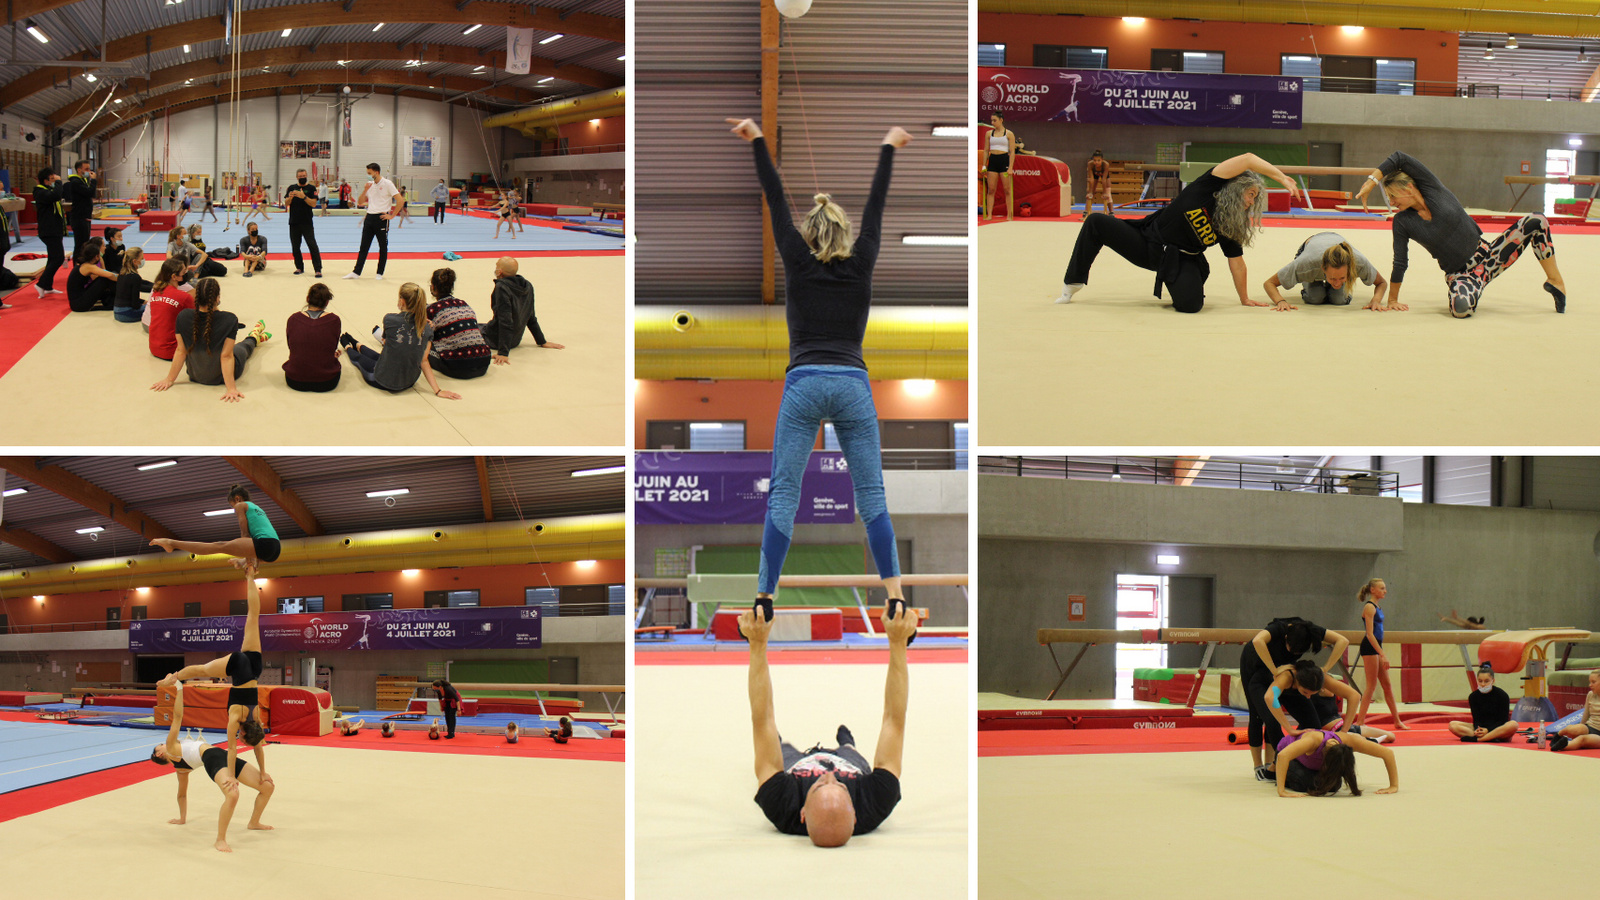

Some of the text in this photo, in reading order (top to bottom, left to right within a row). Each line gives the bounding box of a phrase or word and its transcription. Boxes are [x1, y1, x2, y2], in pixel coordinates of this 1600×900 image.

[1006, 84, 1050, 94] WORLD
[1104, 88, 1189, 100] DU 21 JUIN AU
[1006, 94, 1039, 104] ACRO
[1103, 98, 1197, 110] 4 JUILLET 2021
[1185, 208, 1217, 245] ACRO
[635, 475, 699, 488] JUIN AU
[669, 489, 709, 502] 2021
[401, 622, 411, 630] 21
[413, 622, 435, 630] JUIN
[436, 622, 450, 630] AU
